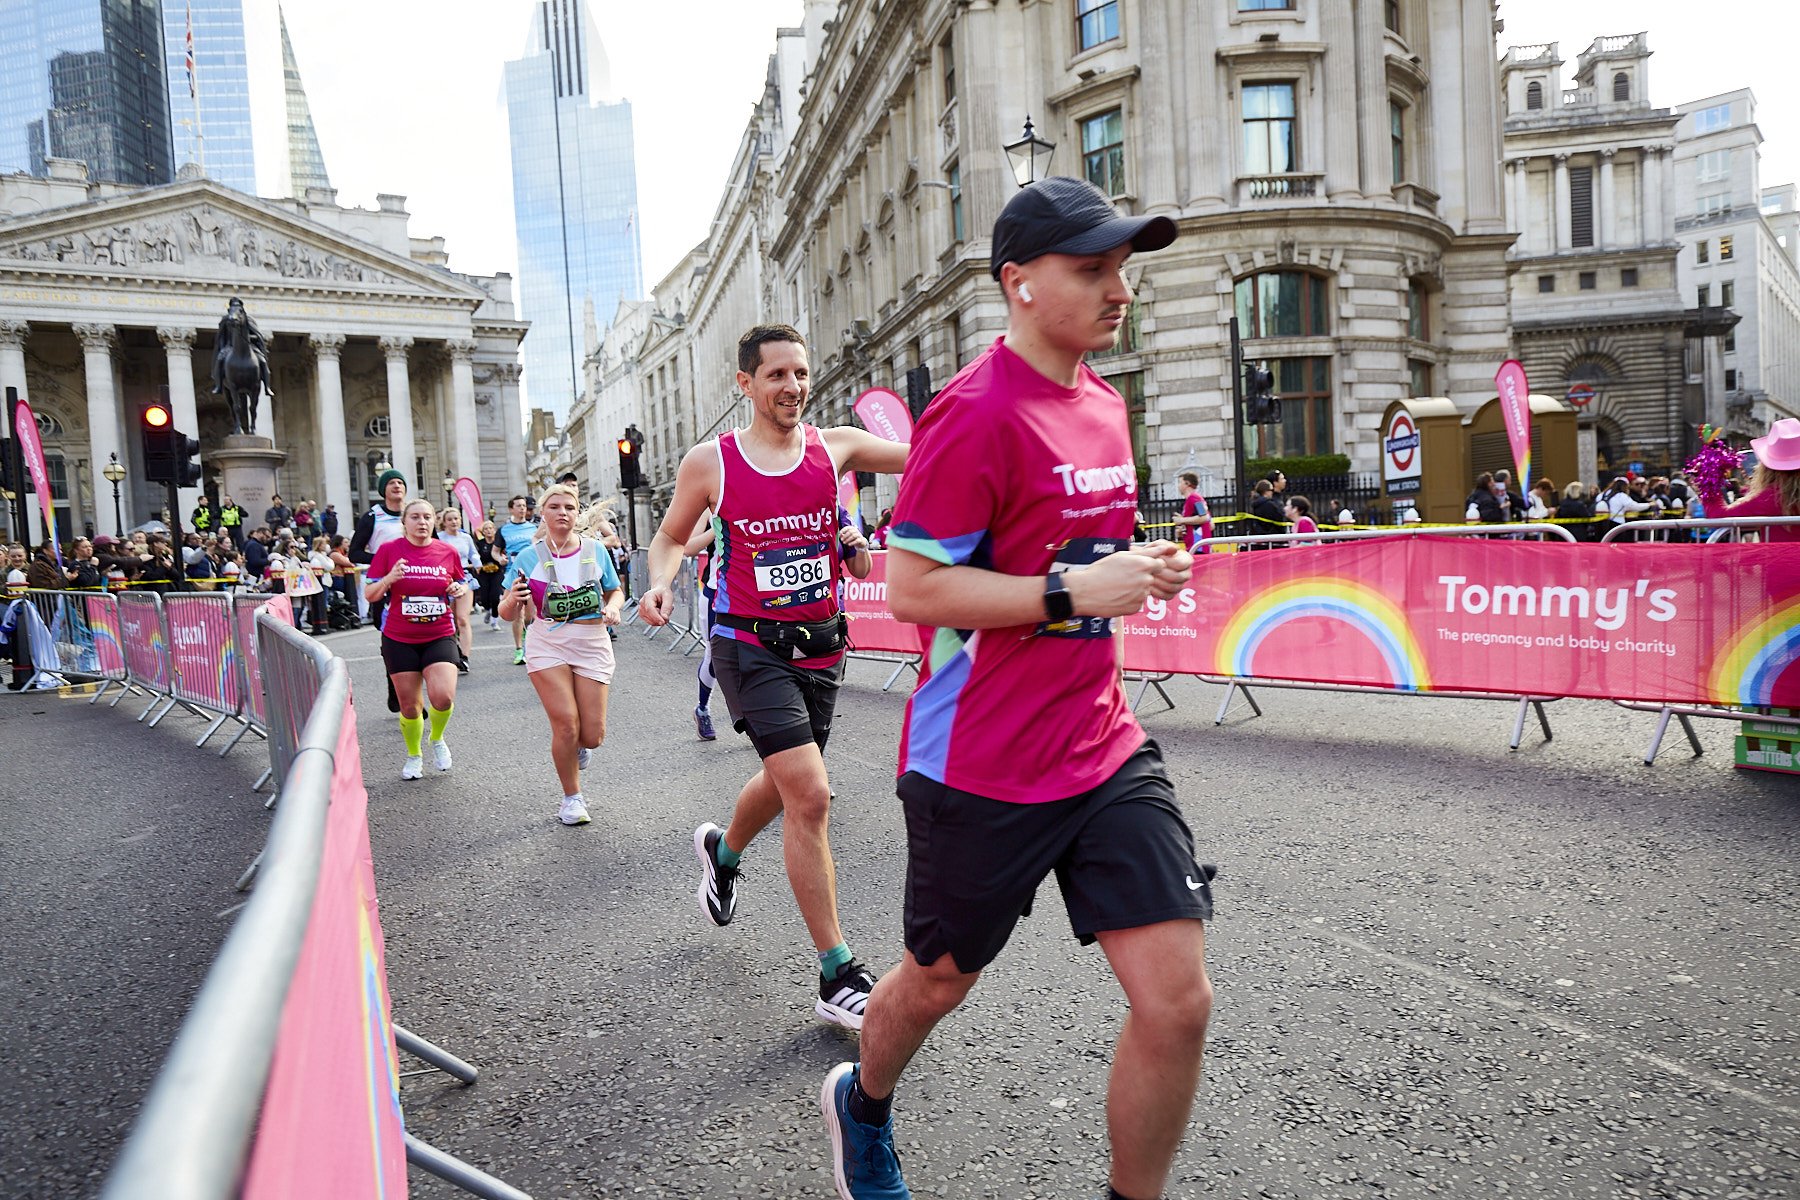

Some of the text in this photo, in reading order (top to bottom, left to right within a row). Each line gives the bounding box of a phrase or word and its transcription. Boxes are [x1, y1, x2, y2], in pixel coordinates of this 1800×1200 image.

[733, 507, 832, 536] Tommy's
[786, 548, 807, 557] RYAN
[404, 565, 448, 577] ommy's
[770, 560, 823, 588] 8986
[844, 576, 887, 601] Tomm
[406, 603, 443, 614] 23874
[556, 595, 592, 613] 6268
[1438, 575, 1678, 631] Tommy's
[1132, 624, 1157, 637] baby
[1160, 625, 1197, 639] charity
[1437, 628, 1677, 657] The pregnancy and baby charity
